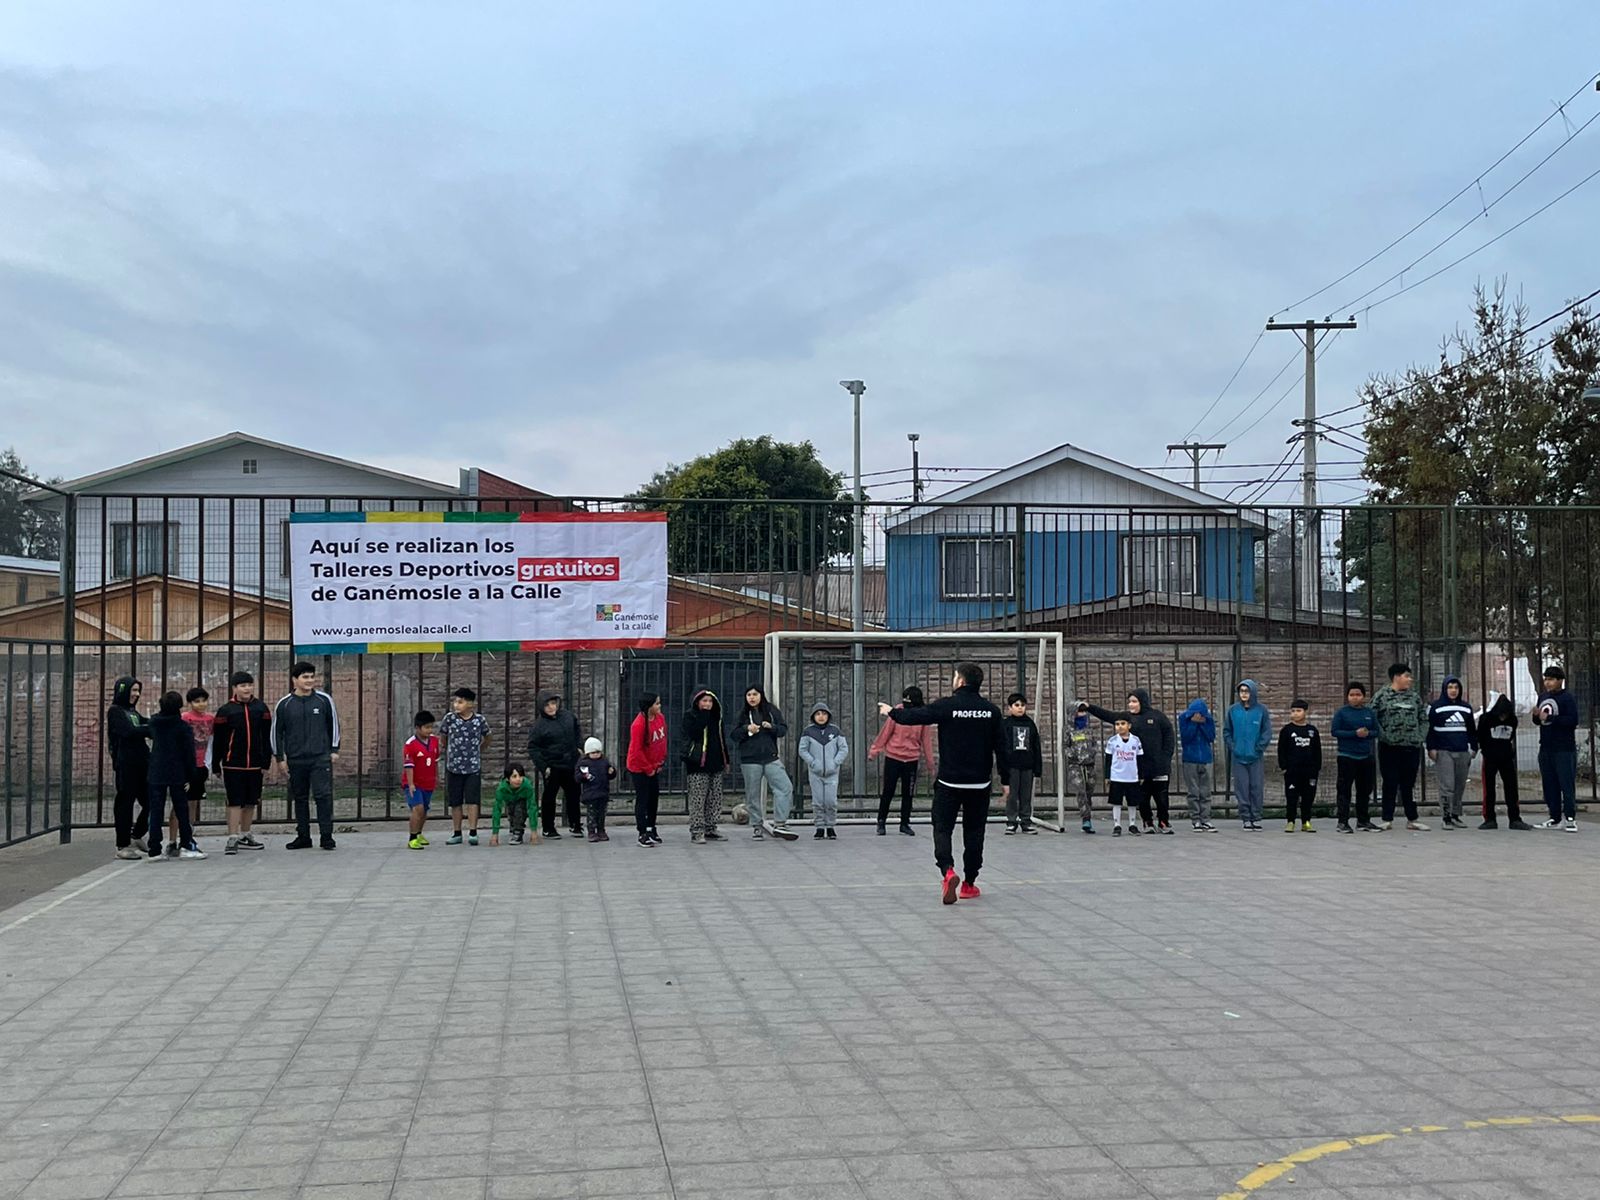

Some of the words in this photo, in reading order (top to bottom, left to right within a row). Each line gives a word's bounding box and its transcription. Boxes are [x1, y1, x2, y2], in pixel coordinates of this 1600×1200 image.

[310, 537, 361, 558] Aquí
[365, 541, 390, 554] se
[395, 536, 479, 554] realizan
[485, 538, 515, 553] los
[310, 562, 393, 578] Talleres
[399, 560, 515, 580] Deportivos
[520, 559, 616, 581] gratuitos
[311, 586, 337, 601] de
[344, 584, 462, 601] Ganémosle
[468, 587, 480, 600] a
[486, 584, 504, 600] la
[510, 583, 562, 599] Calle
[614, 612, 660, 622] Ganémosle
[311, 623, 472, 637] www.ganemoslealacalle.cl
[614, 623, 620, 631] a
[621, 622, 630, 631] la
[631, 621, 652, 631] calle
[952, 709, 992, 719] PROFESOR
[426, 757, 432, 767] 8
